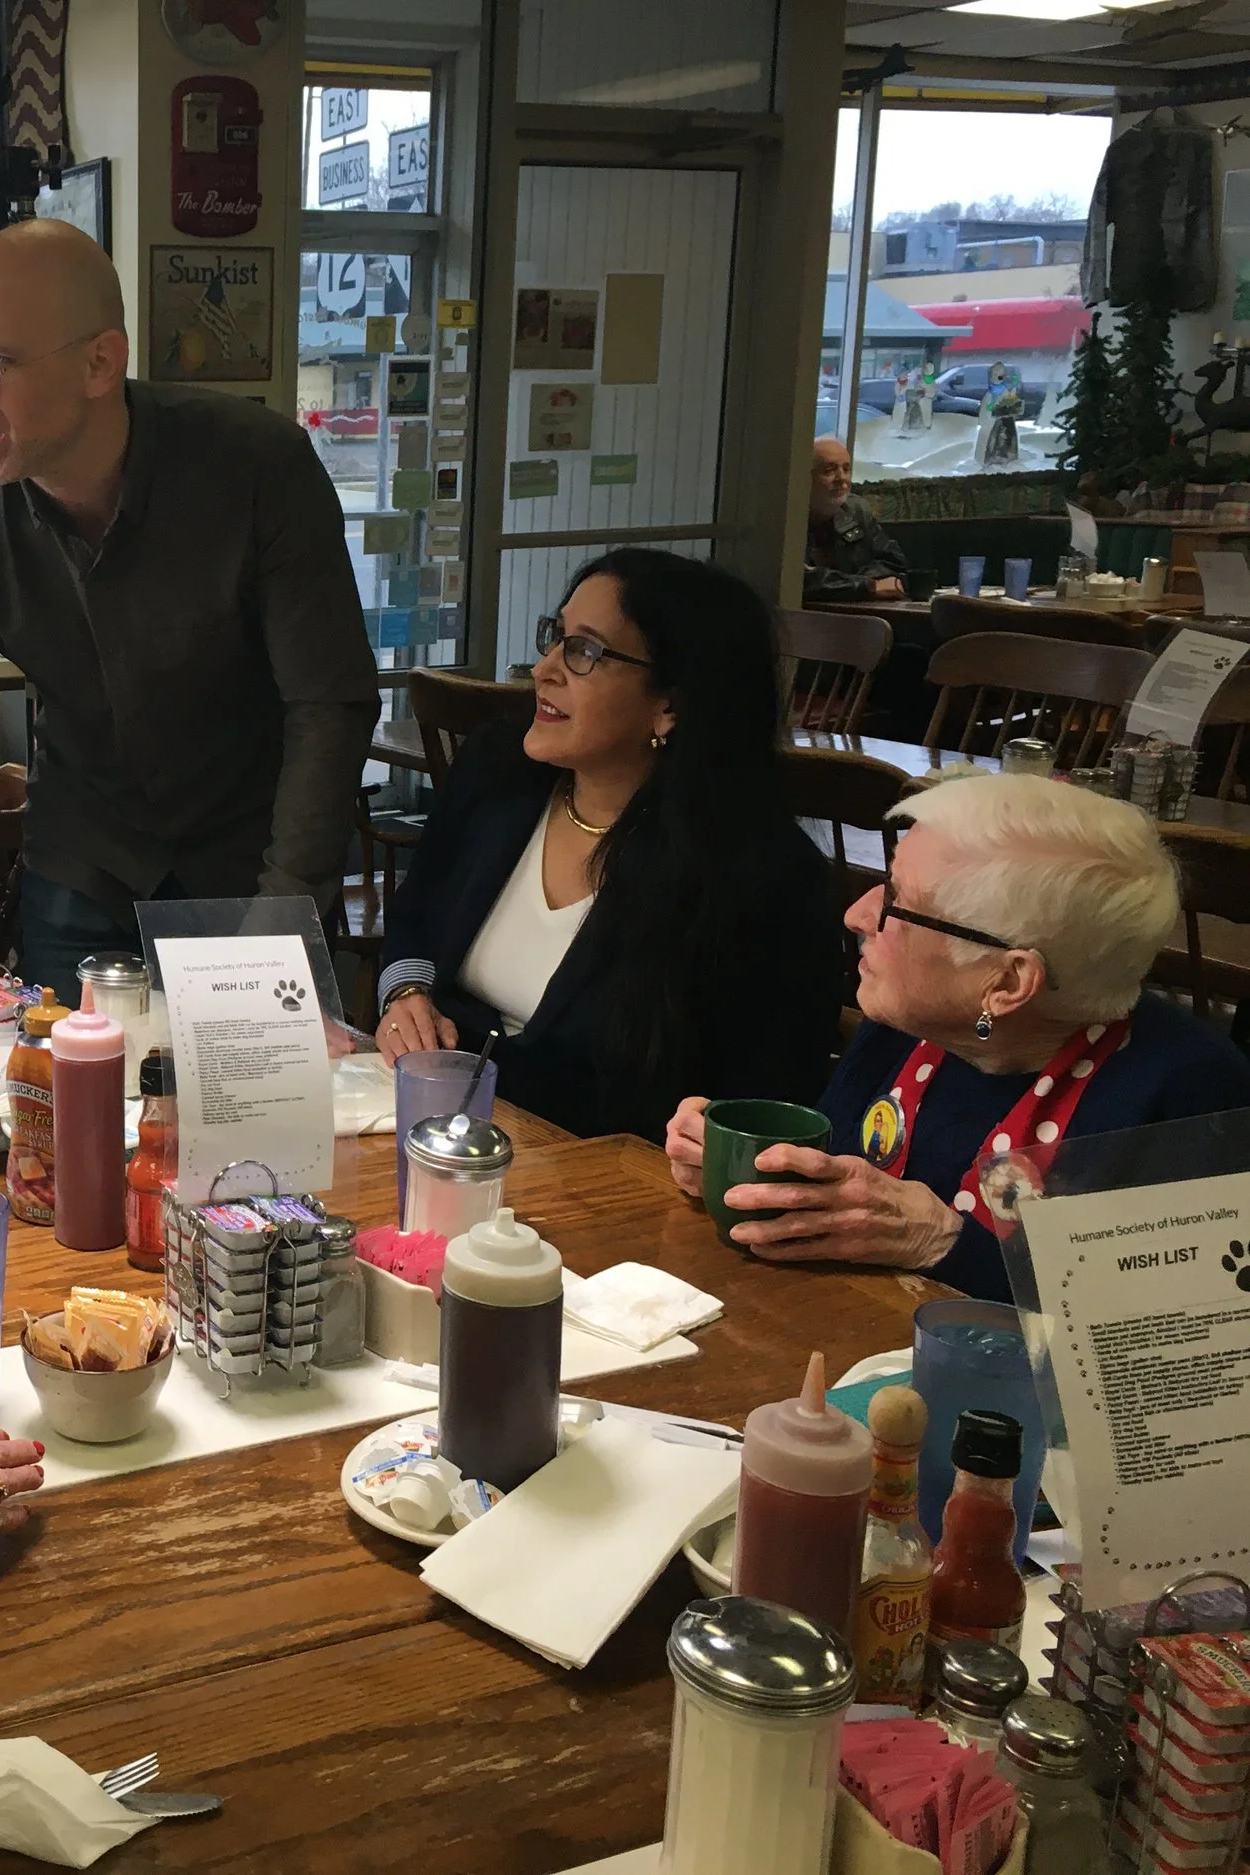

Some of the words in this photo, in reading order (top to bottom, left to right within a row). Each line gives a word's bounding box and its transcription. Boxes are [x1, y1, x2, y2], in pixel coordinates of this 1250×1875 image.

[328, 88, 360, 127] EAST
[323, 156, 365, 192] BUSINESS
[178, 192, 198, 210] The
[168, 254, 259, 285] Sunkist
[328, 254, 356, 292] 12
[183, 965, 211, 973] Humane
[211, 963, 235, 971] Society
[265, 960, 285, 968] Valley
[211, 982, 237, 992] WISH
[240, 980, 261, 991] LIST
[1069, 1228, 1114, 1244] Humane
[1116, 1221, 1155, 1237] Society
[1157, 1217, 1168, 1230] of
[1169, 1213, 1205, 1228] Huron
[1206, 1207, 1239, 1221] Valley
[1117, 1251, 1159, 1272] WISH
[1164, 1246, 1199, 1266] LIST
[869, 1596, 920, 1636] CHOL
